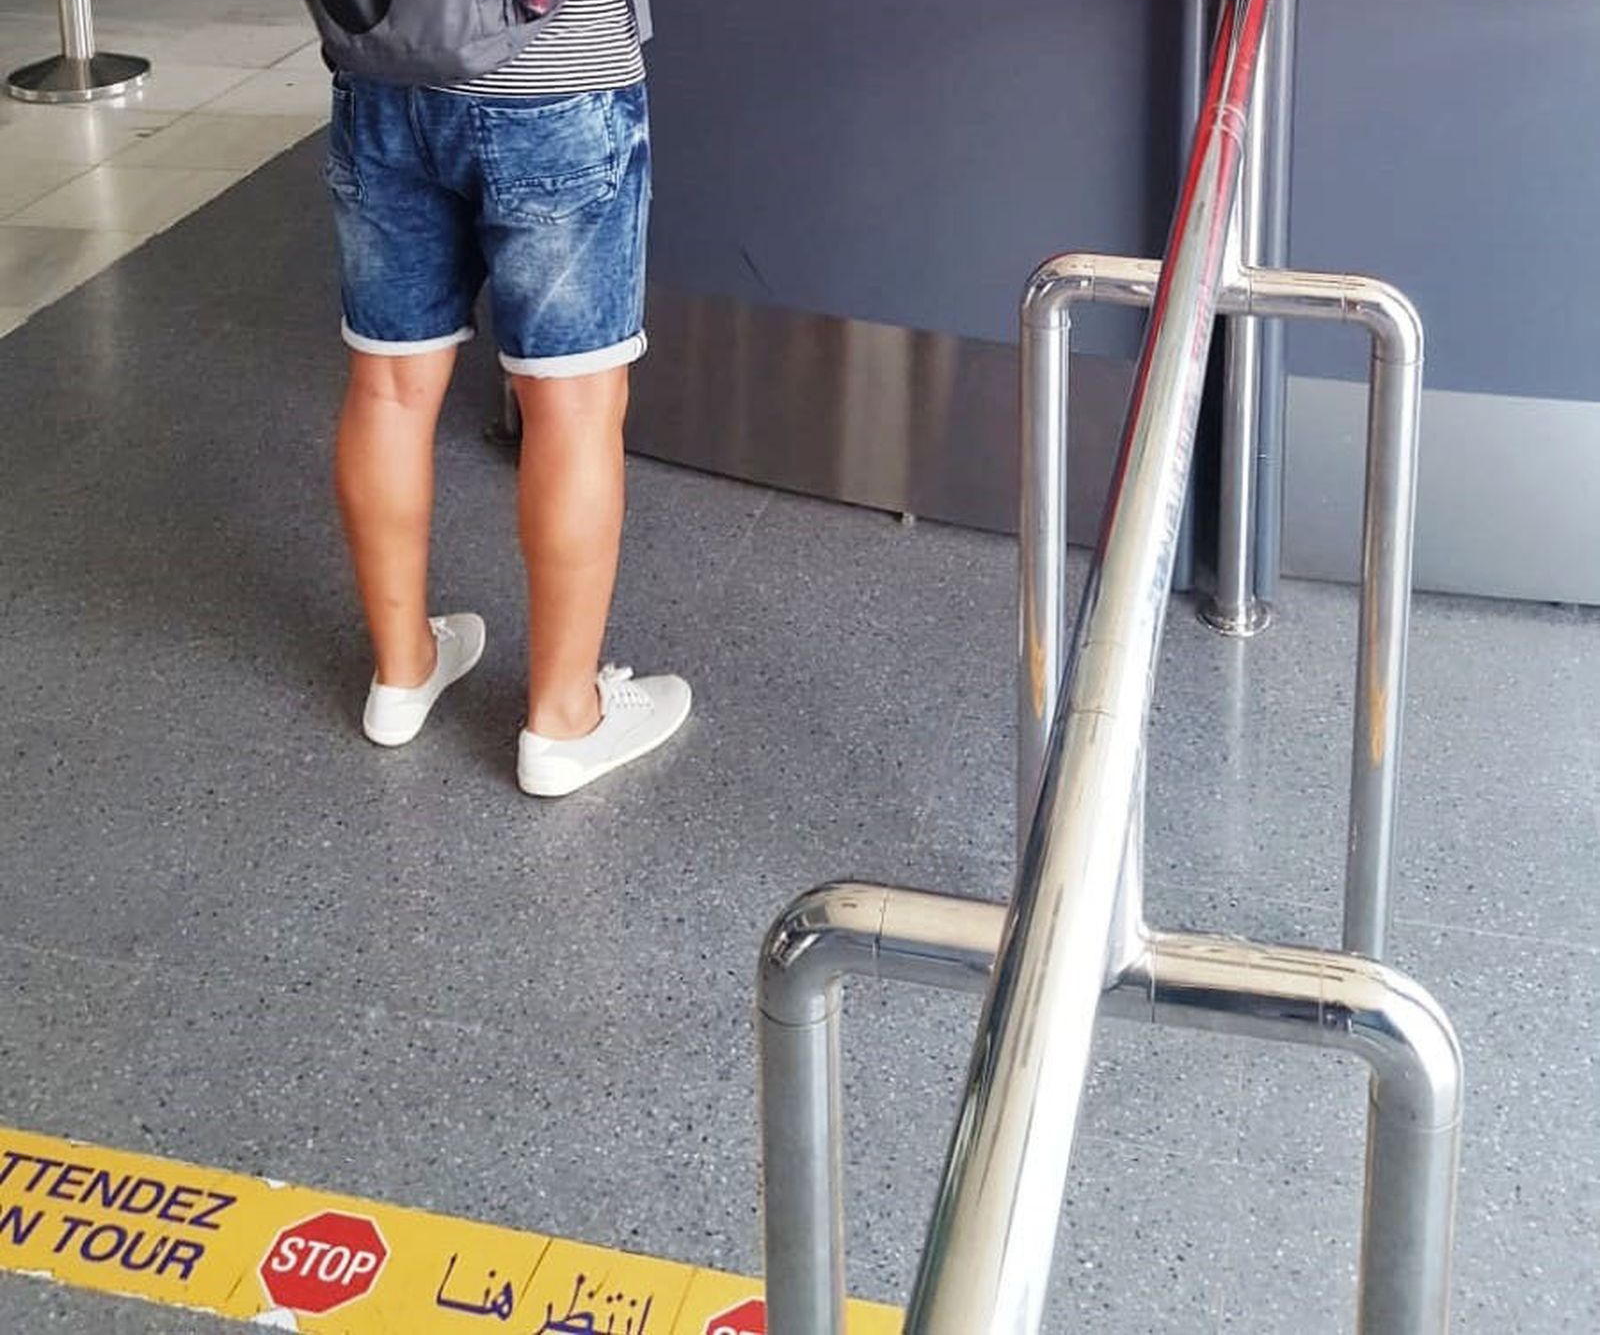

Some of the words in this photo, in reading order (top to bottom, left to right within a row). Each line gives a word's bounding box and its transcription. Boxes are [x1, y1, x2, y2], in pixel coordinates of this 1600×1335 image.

[53, 1215, 205, 1281] TOUR
[271, 1236, 378, 1285] STOP
[435, 1253, 514, 1321] هنا
